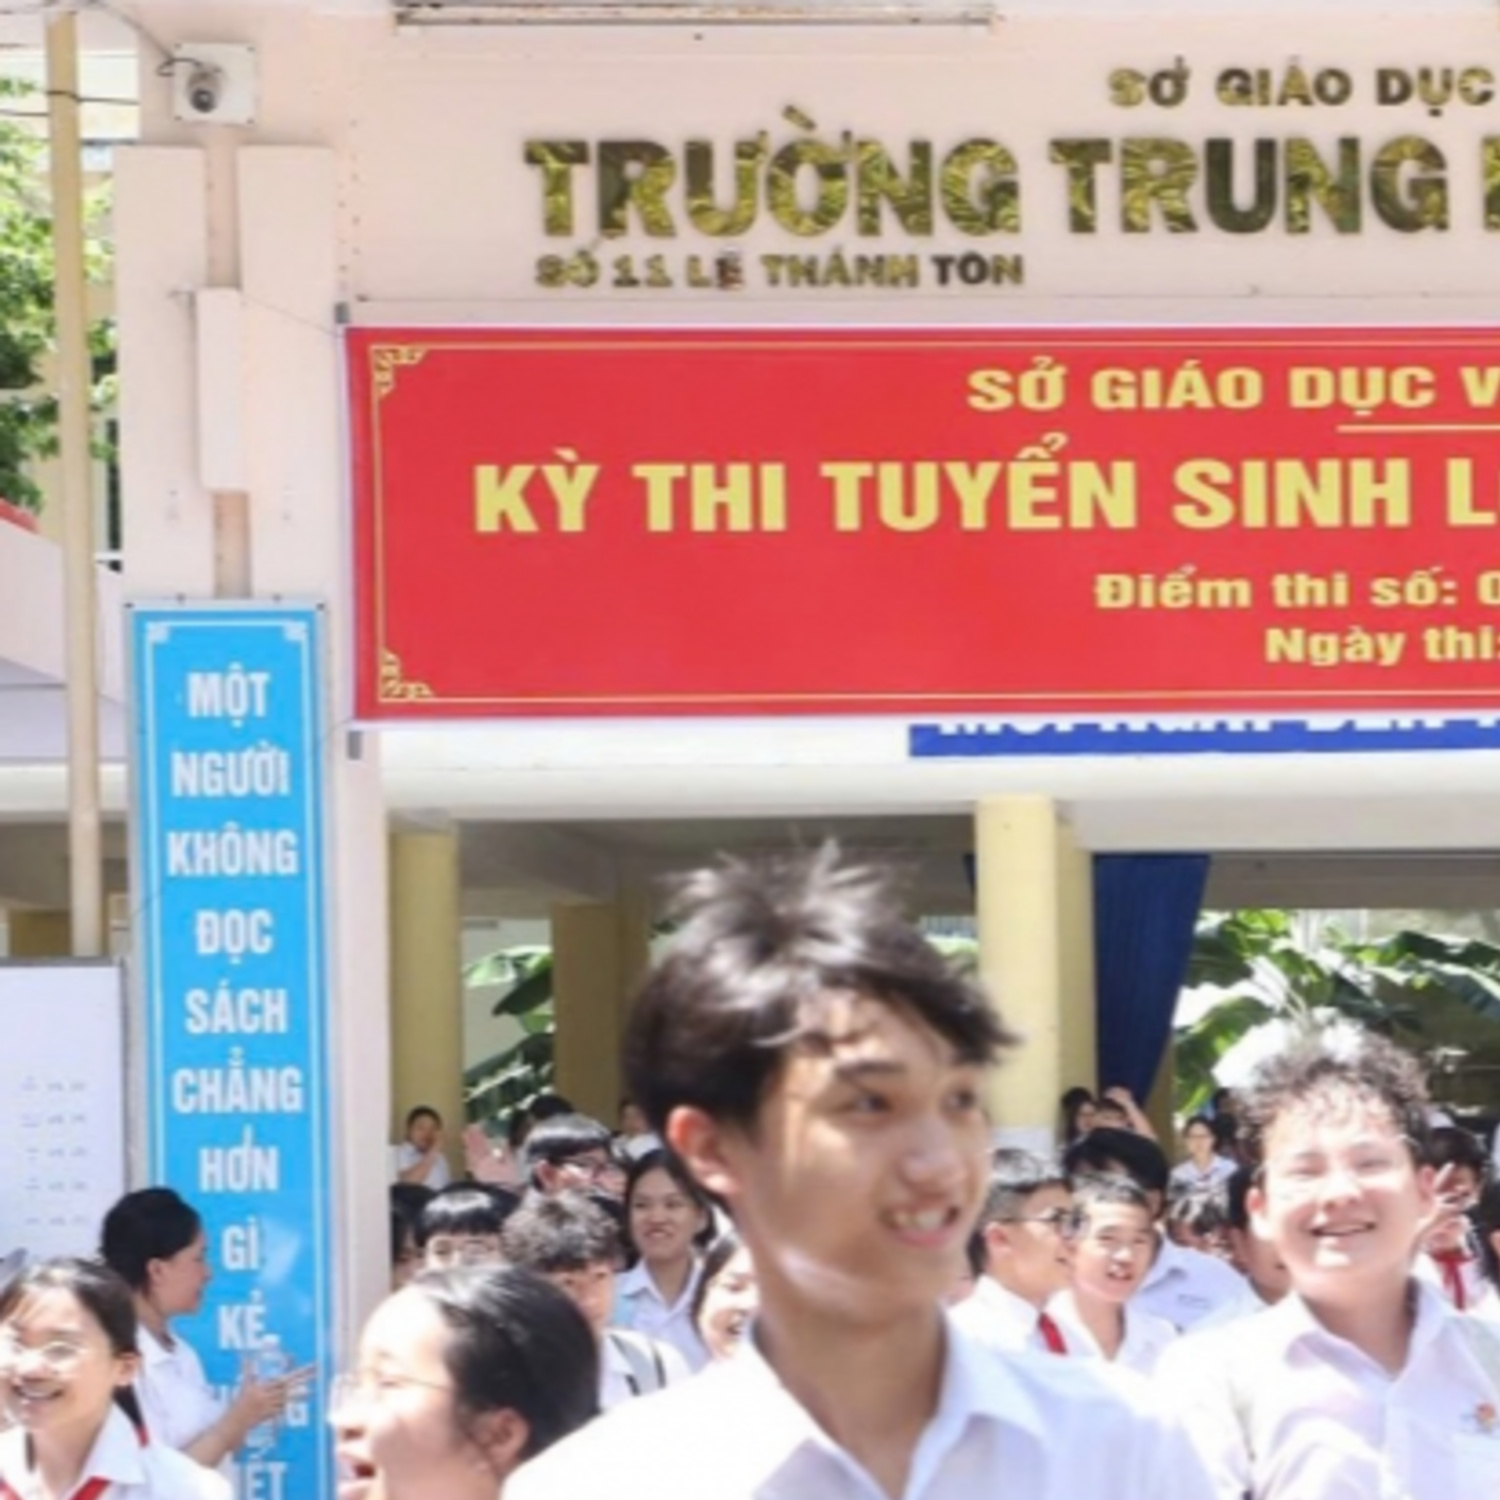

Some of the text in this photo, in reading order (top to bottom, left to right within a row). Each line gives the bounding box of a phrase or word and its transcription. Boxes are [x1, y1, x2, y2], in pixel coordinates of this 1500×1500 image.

[1215, 55, 1353, 107] GIÁO
[1375, 66, 1495, 117] DỤC
[523, 104, 1021, 237] TRƯỜNG
[1048, 134, 1449, 234] TRUNG
[612, 253, 674, 287] 11
[967, 355, 1068, 411] SỞ
[1091, 359, 1263, 411] GIÁO
[1289, 365, 1436, 417] DỤC
[474, 448, 601, 532] KỲ
[631, 462, 787, 532] THI
[819, 432, 1137, 531] TUYỂN
[1172, 457, 1410, 529] SINH
[1094, 564, 1251, 609] Điểm
[1272, 572, 1349, 606] thi
[1370, 566, 1457, 607] số:
[1265, 625, 1406, 667] Ngày
[186, 662, 270, 727] MỘT
[169, 739, 291, 797] NGƯỜI
[166, 821, 299, 877] KHÔNG
[193, 908, 274, 964] ĐỌC
[183, 979, 288, 1035] SÁCH
